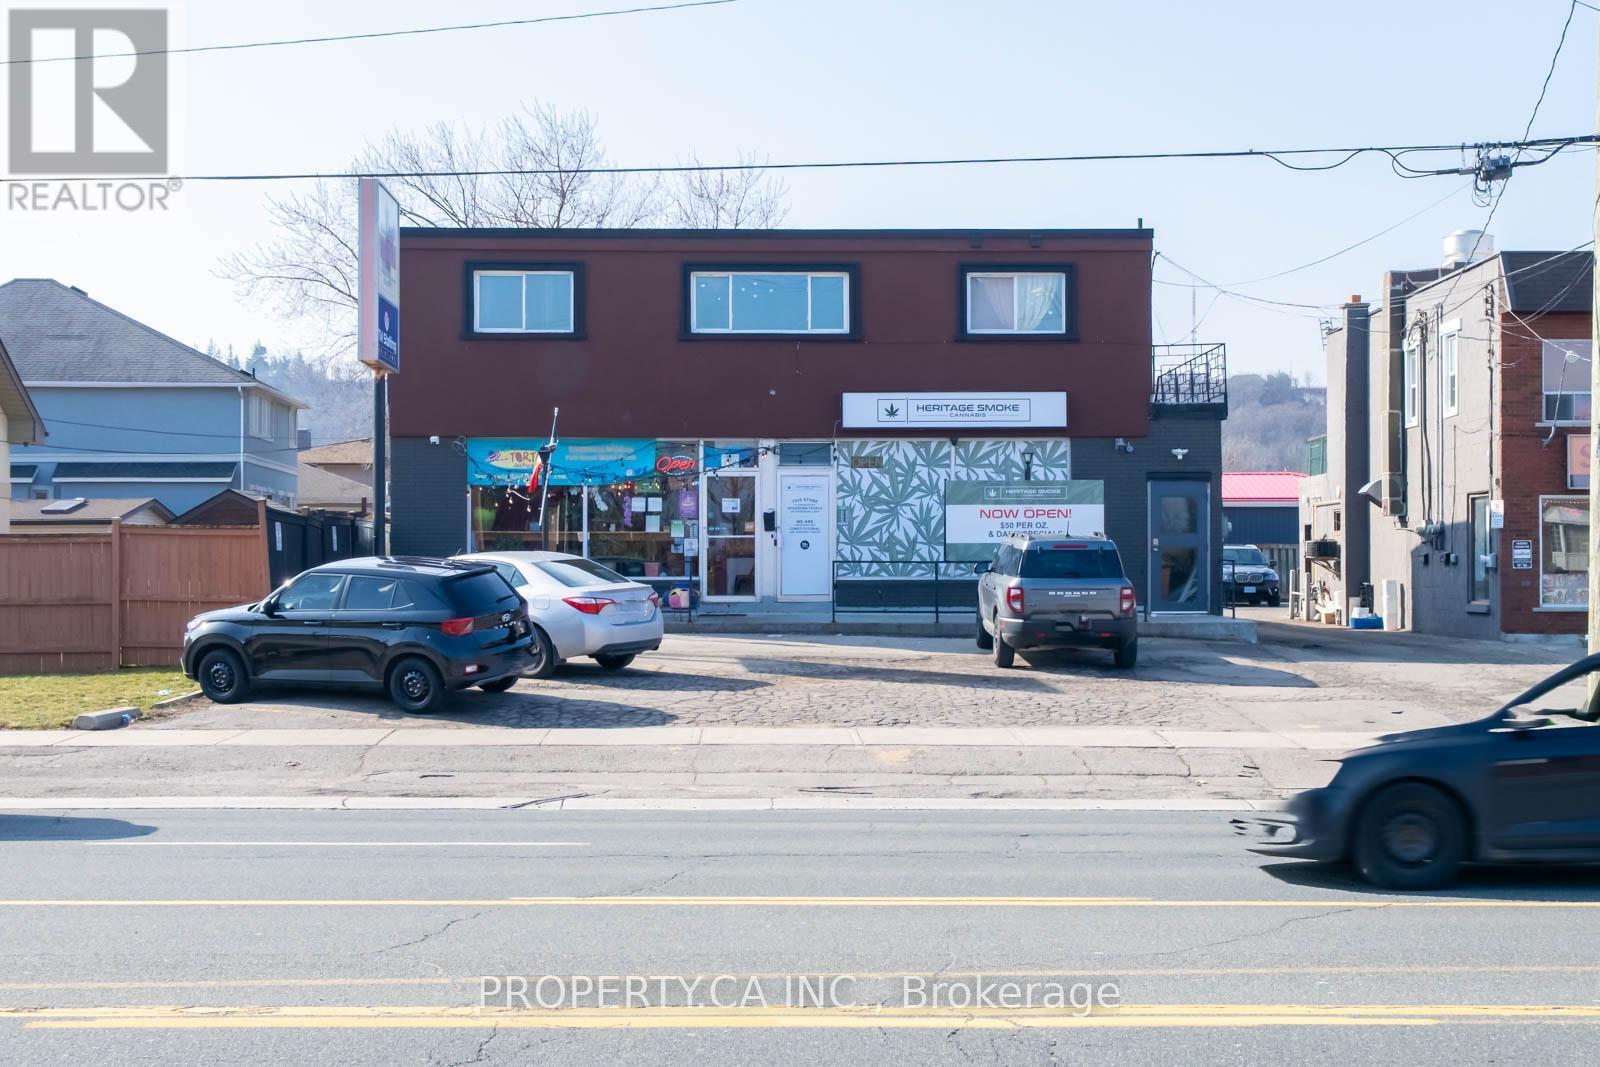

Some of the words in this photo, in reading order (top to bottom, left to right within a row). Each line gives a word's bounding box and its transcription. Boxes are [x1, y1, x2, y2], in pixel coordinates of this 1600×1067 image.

[916, 404, 974, 412] HERITAGE
[977, 404, 1019, 412] SMOKE
[656, 456, 697, 472] Open
[979, 508, 1019, 519] NOW
[1023, 508, 1072, 519] OPEN!
[1000, 521, 1014, 529] $50
[1016, 521, 1033, 529] PER
[1035, 521, 1049, 529] OZ.
[988, 530, 994, 538] &
